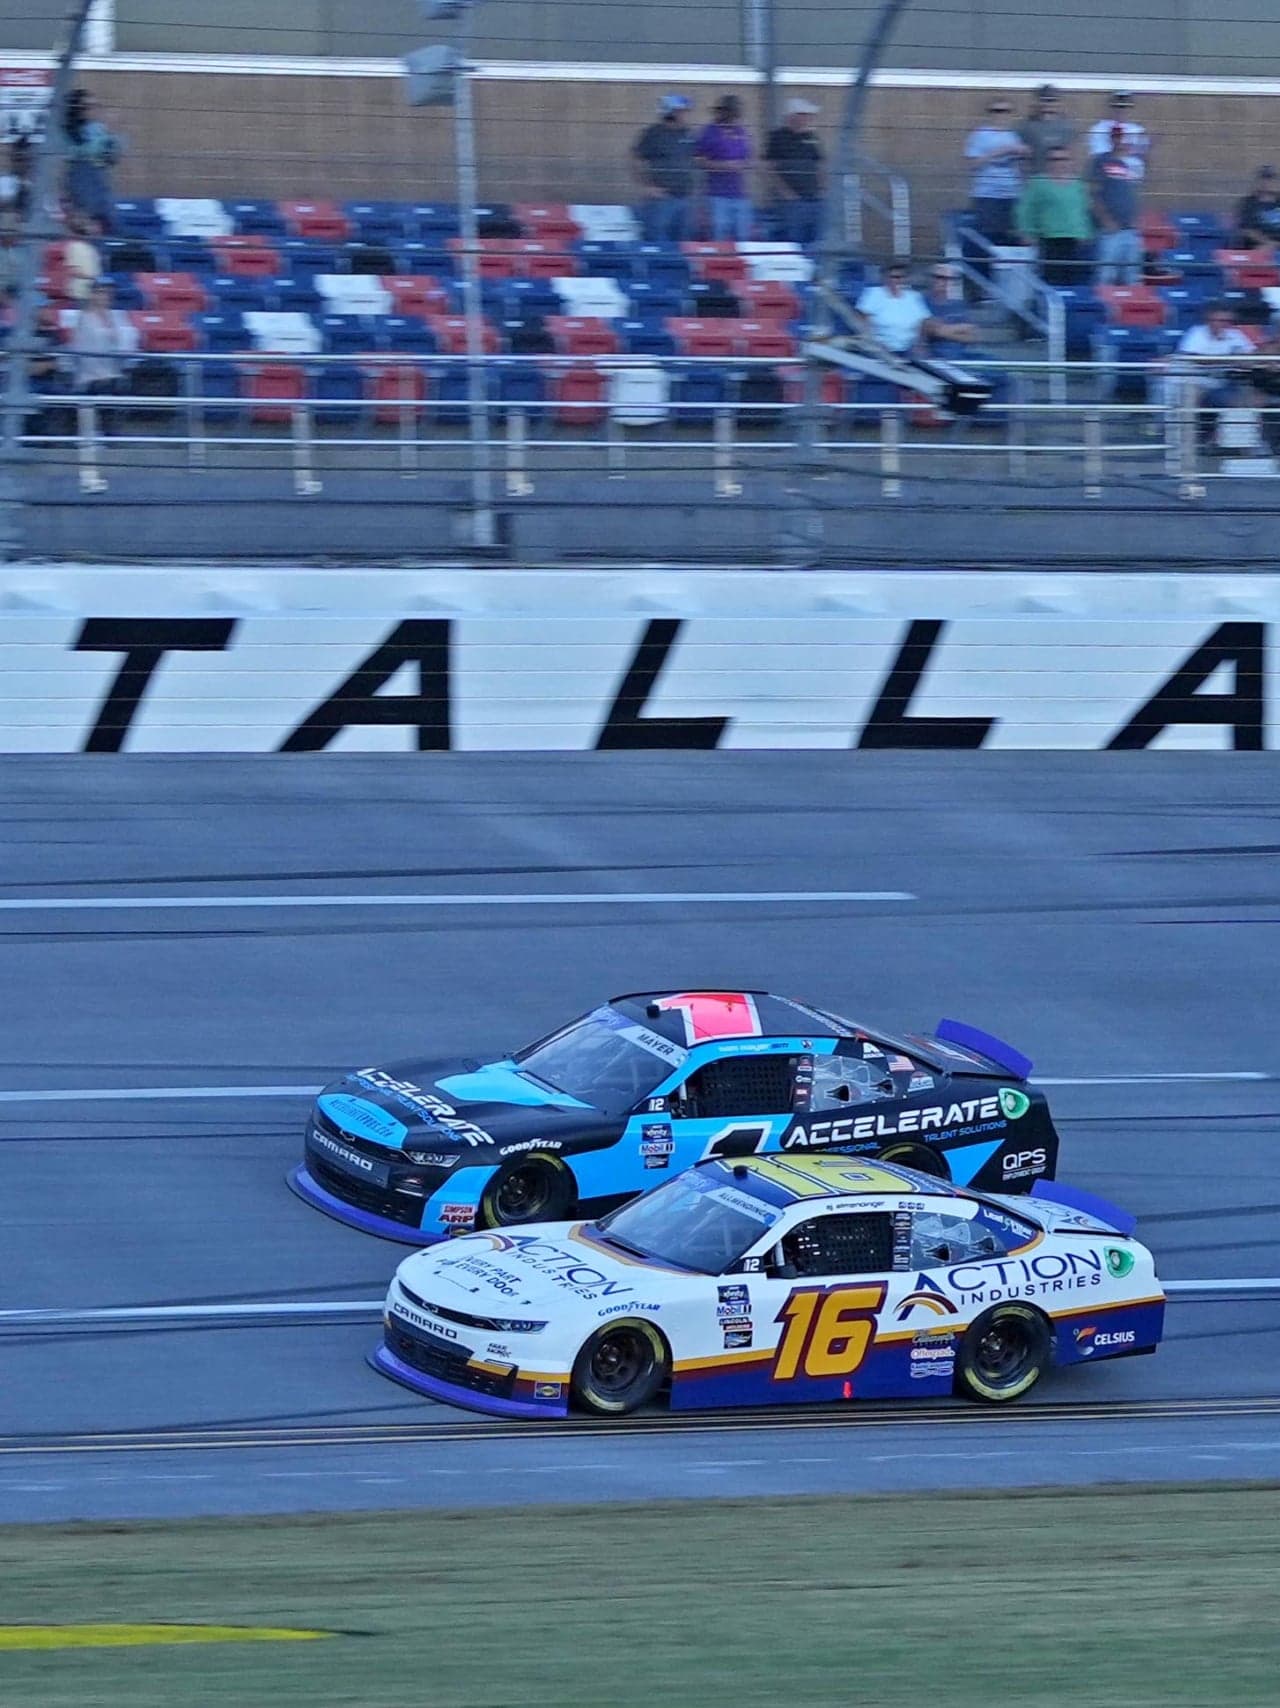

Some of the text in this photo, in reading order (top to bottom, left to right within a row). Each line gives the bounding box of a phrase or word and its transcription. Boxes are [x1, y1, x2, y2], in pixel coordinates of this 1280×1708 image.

[637, 1034, 675, 1055] MAYER
[648, 1098, 664, 1112] 12
[785, 1096, 1000, 1148] ACCELERATE
[958, 1119, 1008, 1136] SOLUTIONS
[312, 1129, 374, 1171] CAMARO
[499, 1138, 563, 1156] GOODYEAR
[1002, 1148, 1047, 1171] QPS
[438, 1214, 474, 1223] ARP
[743, 1258, 761, 1272] 12
[893, 1248, 1103, 1322] ACTION
[960, 1272, 1102, 1306] INDUSTRIES
[597, 1300, 663, 1318] GOODYEAR
[717, 1305, 742, 1314] Mobil
[393, 1302, 458, 1340] CAMARO
[771, 1281, 889, 1382] 16
[1094, 1330, 1136, 1346] CELSIUS
